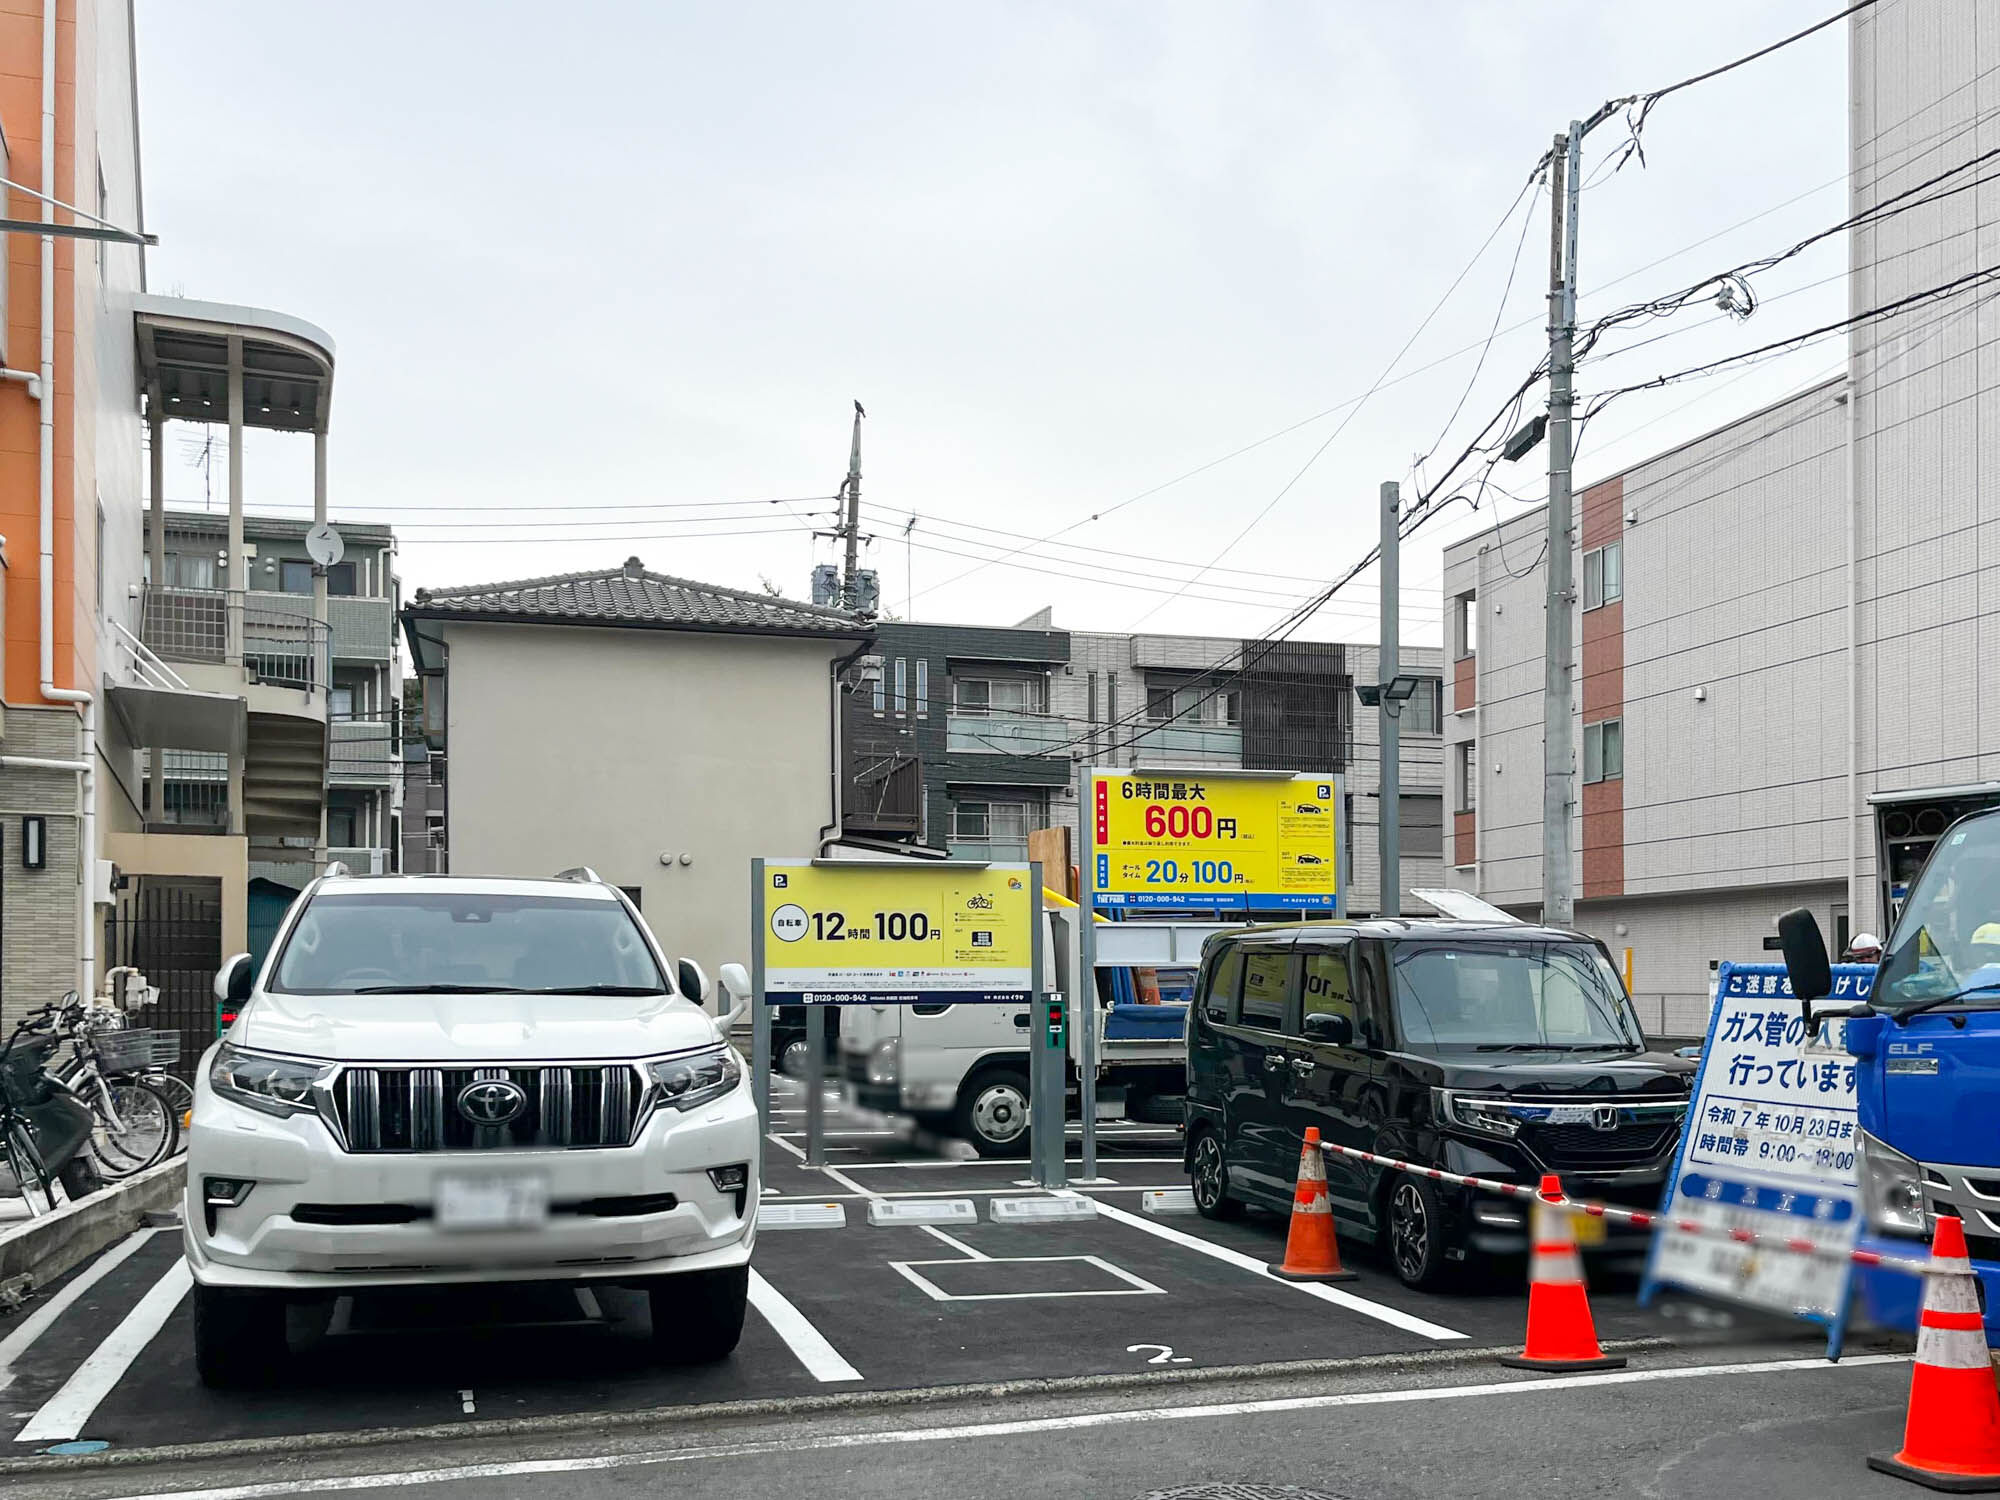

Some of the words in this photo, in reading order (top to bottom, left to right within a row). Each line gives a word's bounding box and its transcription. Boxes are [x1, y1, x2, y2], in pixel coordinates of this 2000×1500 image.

[1122, 781, 1206, 801] 6時間最大
[777, 919, 802, 927] 自転車
[1889, 1043, 1934, 1055] ELF
[1700, 1133, 1749, 1157] 時間帯
